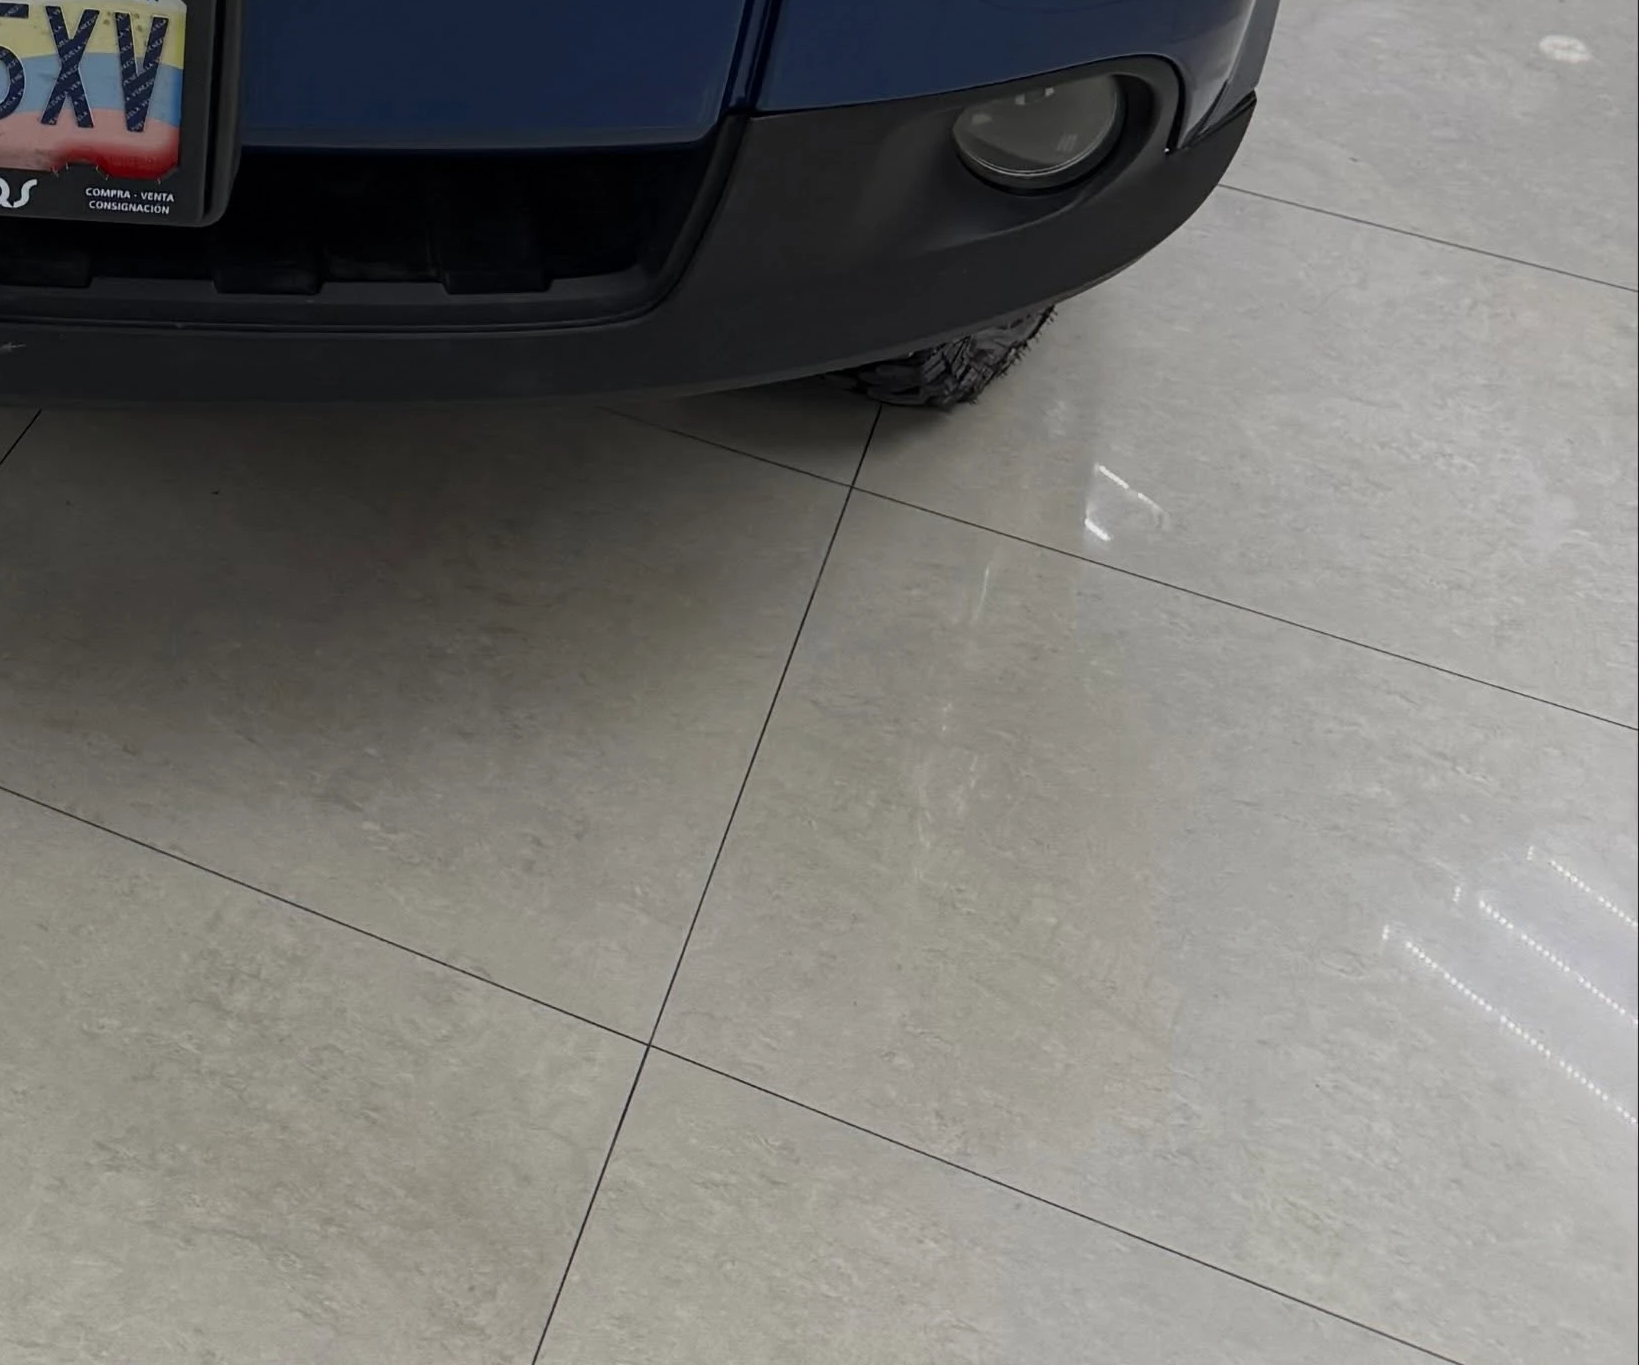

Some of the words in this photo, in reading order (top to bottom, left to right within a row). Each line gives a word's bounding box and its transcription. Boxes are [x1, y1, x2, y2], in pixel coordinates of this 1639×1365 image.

[85, 187, 131, 199] COMPRA
[140, 191, 175, 203] VENTA
[89, 200, 170, 214] CONSIGNACIÓN
